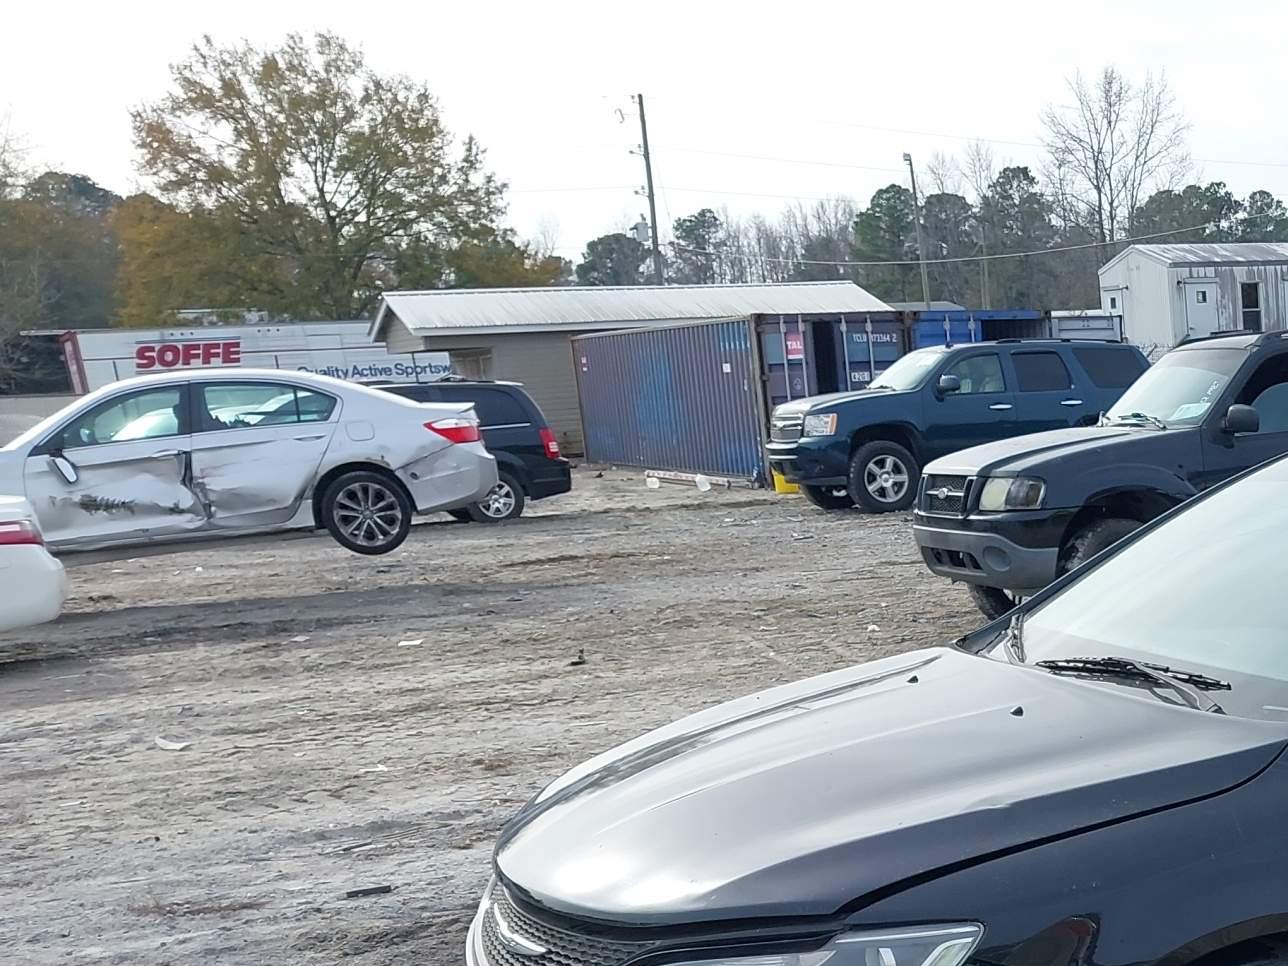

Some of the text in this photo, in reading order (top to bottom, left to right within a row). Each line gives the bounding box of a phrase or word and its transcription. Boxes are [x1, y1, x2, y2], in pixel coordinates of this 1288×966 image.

[786, 340, 803, 350] TAL
[135, 341, 240, 369] SOFFE
[351, 364, 393, 378] Active
